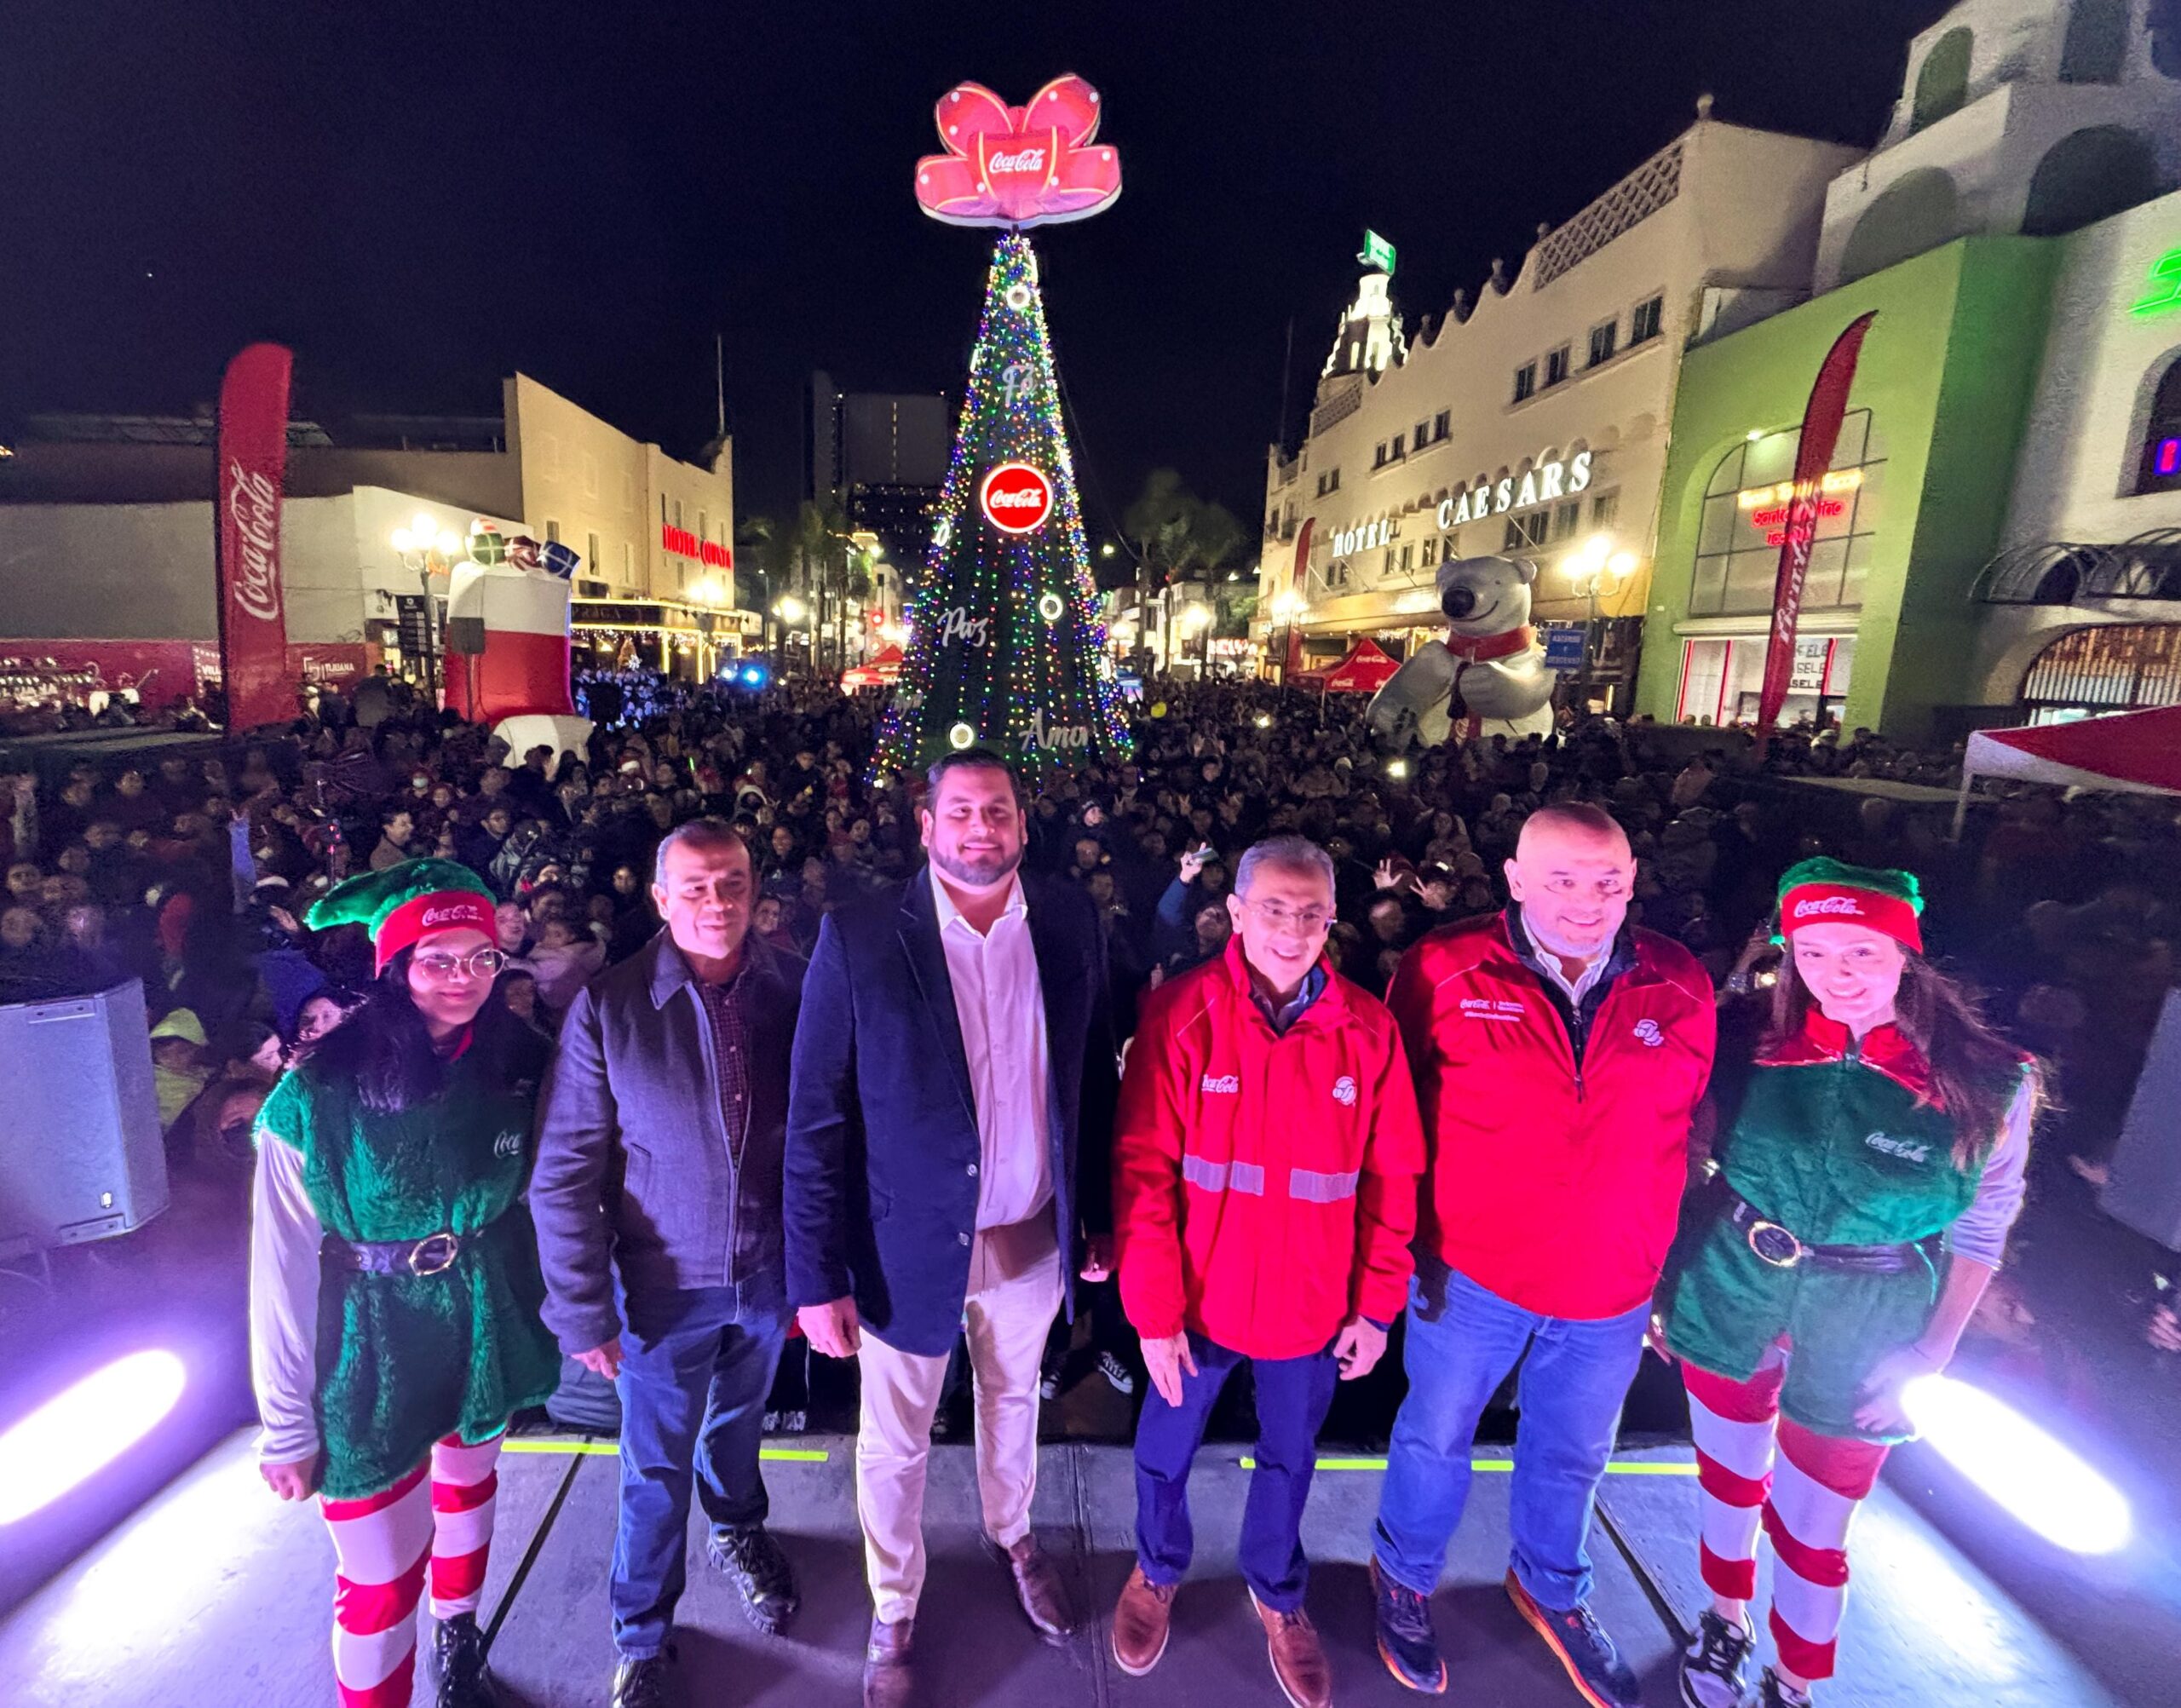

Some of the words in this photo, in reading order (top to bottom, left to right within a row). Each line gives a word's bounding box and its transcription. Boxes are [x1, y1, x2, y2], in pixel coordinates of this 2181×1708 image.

[988, 148, 1045, 174] Coca-Cola
[989, 487, 1043, 509] Coca-Cola
[1332, 518, 1391, 558] HOTEL
[1437, 450, 1592, 531] CAESARS
[230, 456, 279, 620] Coca-Cola
[936, 607, 989, 647] Paz
